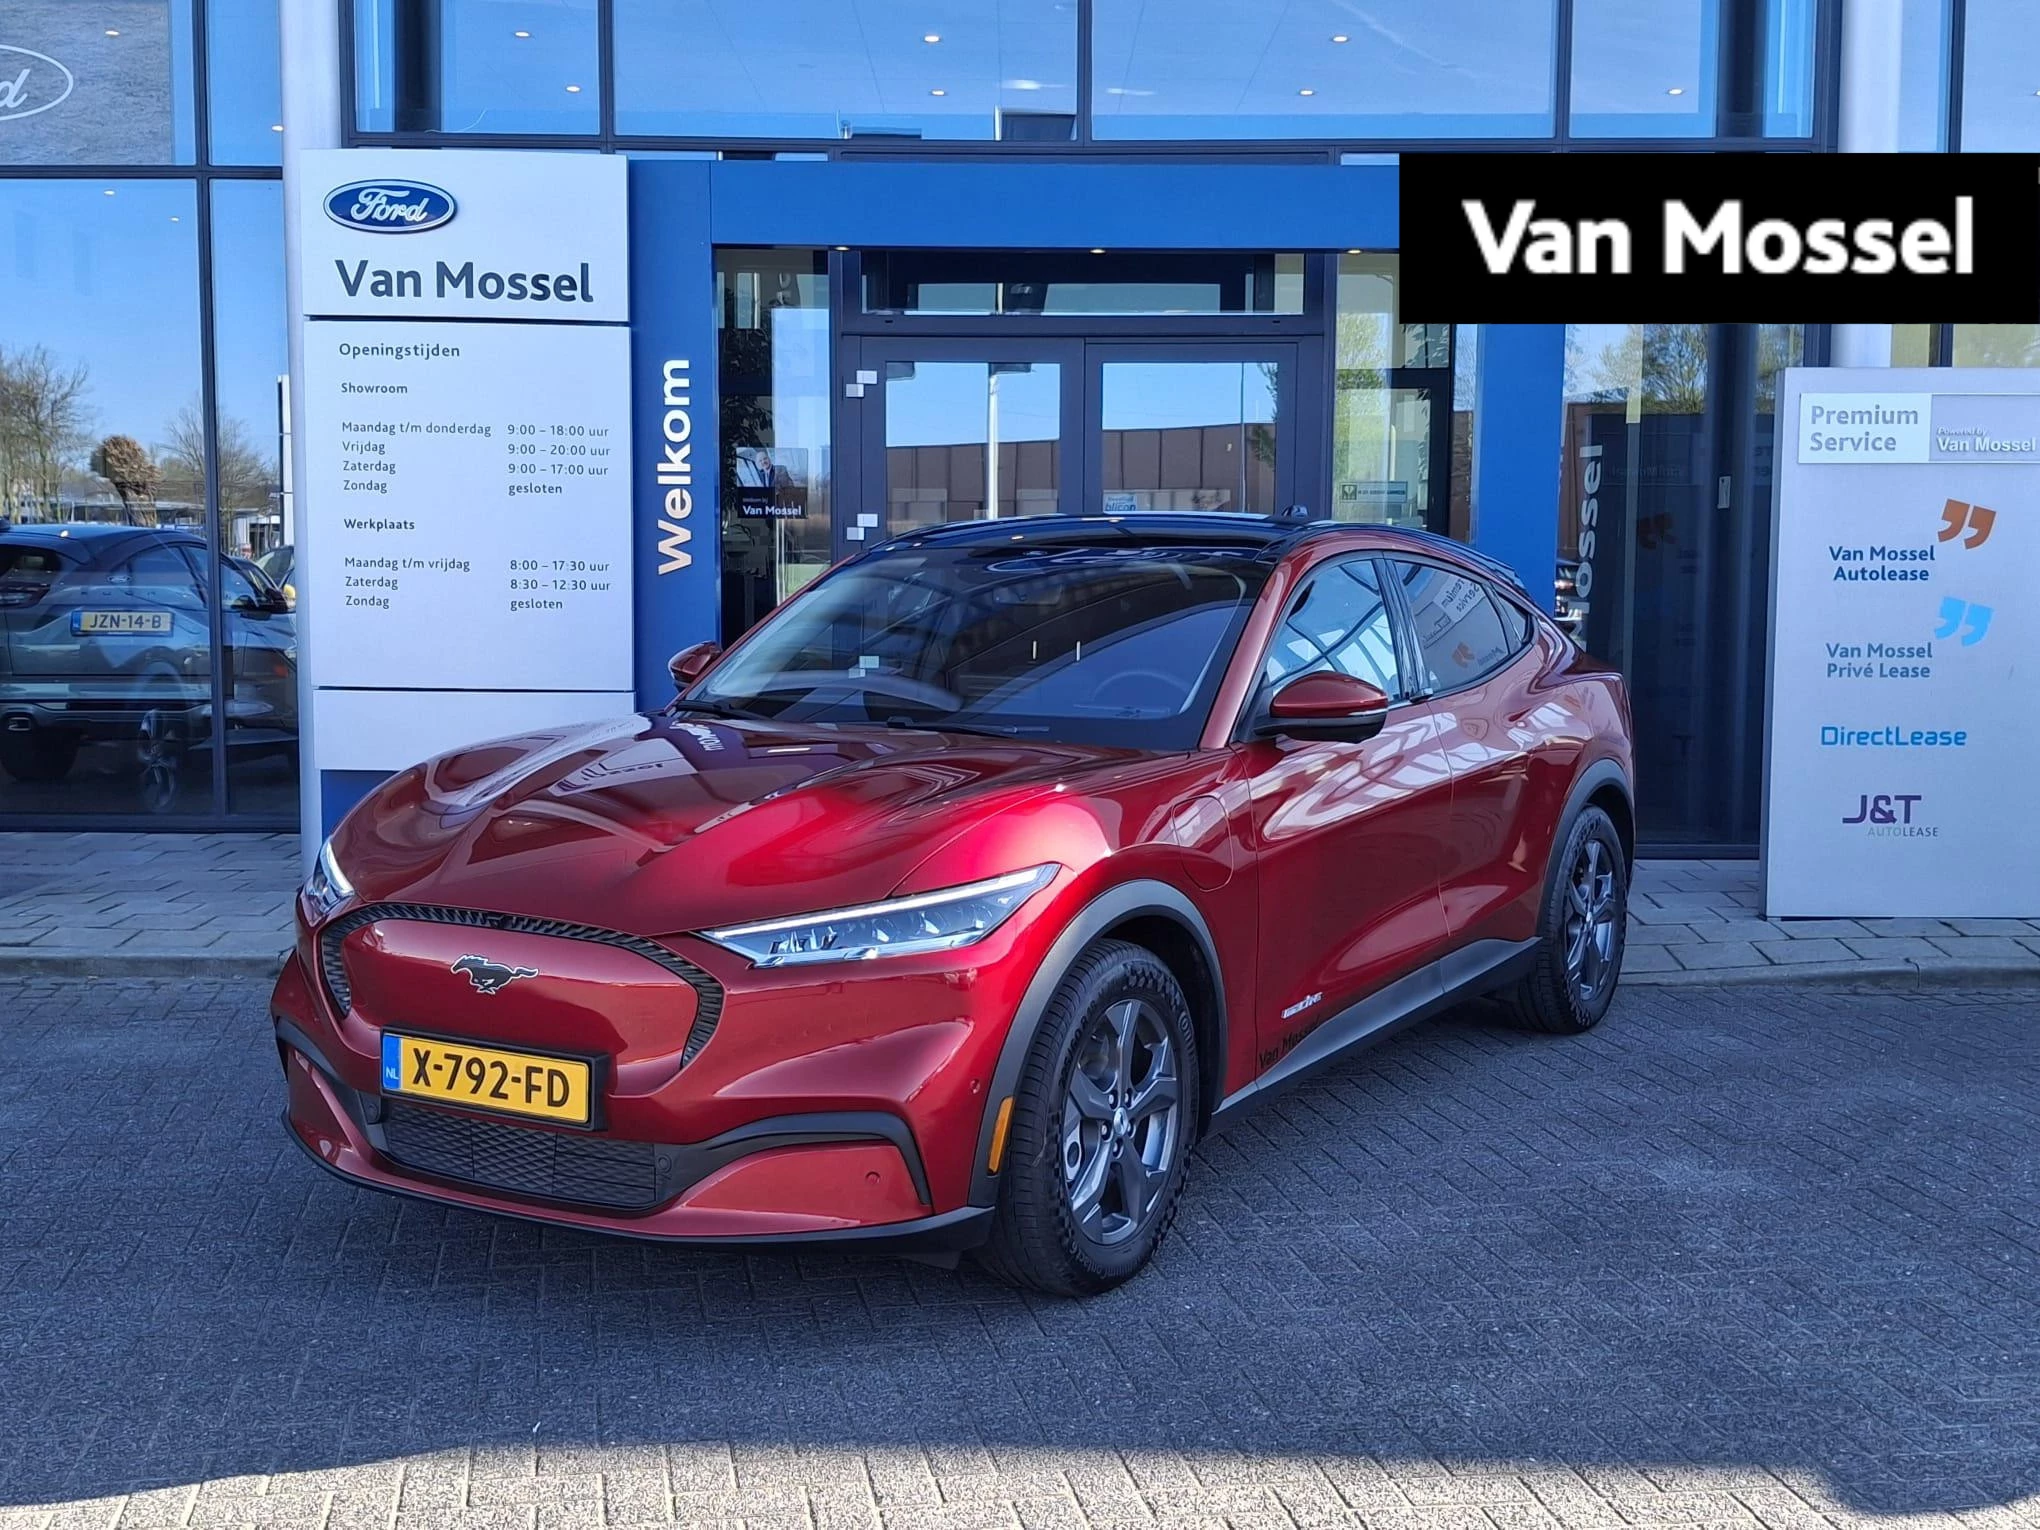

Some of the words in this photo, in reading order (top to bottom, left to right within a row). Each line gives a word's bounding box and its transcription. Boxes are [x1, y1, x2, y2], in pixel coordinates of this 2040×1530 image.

[350, 187, 430, 223] Ford
[335, 259, 422, 299] Van
[435, 261, 594, 303] Mossel
[339, 343, 461, 361] Openingstijden
[341, 382, 408, 395] Showroom
[1810, 404, 1919, 425] Premium
[341, 421, 396, 437] Maandag
[400, 421, 422, 435] t/m
[425, 422, 492, 438] donderdag
[507, 425, 536, 437] 9:00
[549, 425, 585, 438] 18:00
[588, 428, 609, 438] uur
[341, 440, 386, 456] Vrijdag
[507, 444, 536, 456] 9:00
[550, 445, 587, 457] 20:00
[589, 447, 611, 458] uur
[1810, 431, 1898, 451] Service
[1937, 436, 1970, 452] Van
[1974, 436, 2037, 452] Mossel
[343, 459, 396, 475] Zaterdag
[508, 463, 537, 475] 9:00
[550, 464, 585, 476] 17:00
[588, 466, 609, 477] uur
[657, 358, 693, 576] Welkom
[343, 479, 388, 495] Zondag
[508, 482, 563, 497] gesloten
[742, 505, 763, 516] Van
[765, 505, 802, 516] Mossel
[344, 518, 416, 532] Werkplaats
[1829, 545, 1864, 561] Van
[1869, 545, 1936, 561] Mossel
[344, 557, 399, 572] Maandag
[402, 557, 425, 570] t/m
[428, 558, 471, 573] vrijdag
[510, 560, 539, 571] 8:00
[551, 560, 586, 572] 17:30
[589, 563, 610, 573] uur
[1833, 565, 1930, 582] Autolease
[345, 576, 399, 591] Zaterdag
[510, 579, 539, 591] 8:30
[551, 579, 587, 592] 12:30
[590, 582, 611, 592] uur
[345, 595, 390, 610] Zondag
[510, 598, 563, 613] gesloten
[89, 615, 162, 629] JZN-14-B
[1826, 642, 1862, 659] Van
[1867, 642, 1933, 659] Mossel
[1826, 662, 1874, 678] Privé
[1879, 662, 1931, 678] Lease
[1820, 726, 1968, 746] DirectLease
[1842, 794, 1922, 824] J&T
[1867, 826, 1939, 838] AUTOLEASE
[385, 1067, 400, 1081] NL
[412, 1047, 570, 1108] X-792-FD
